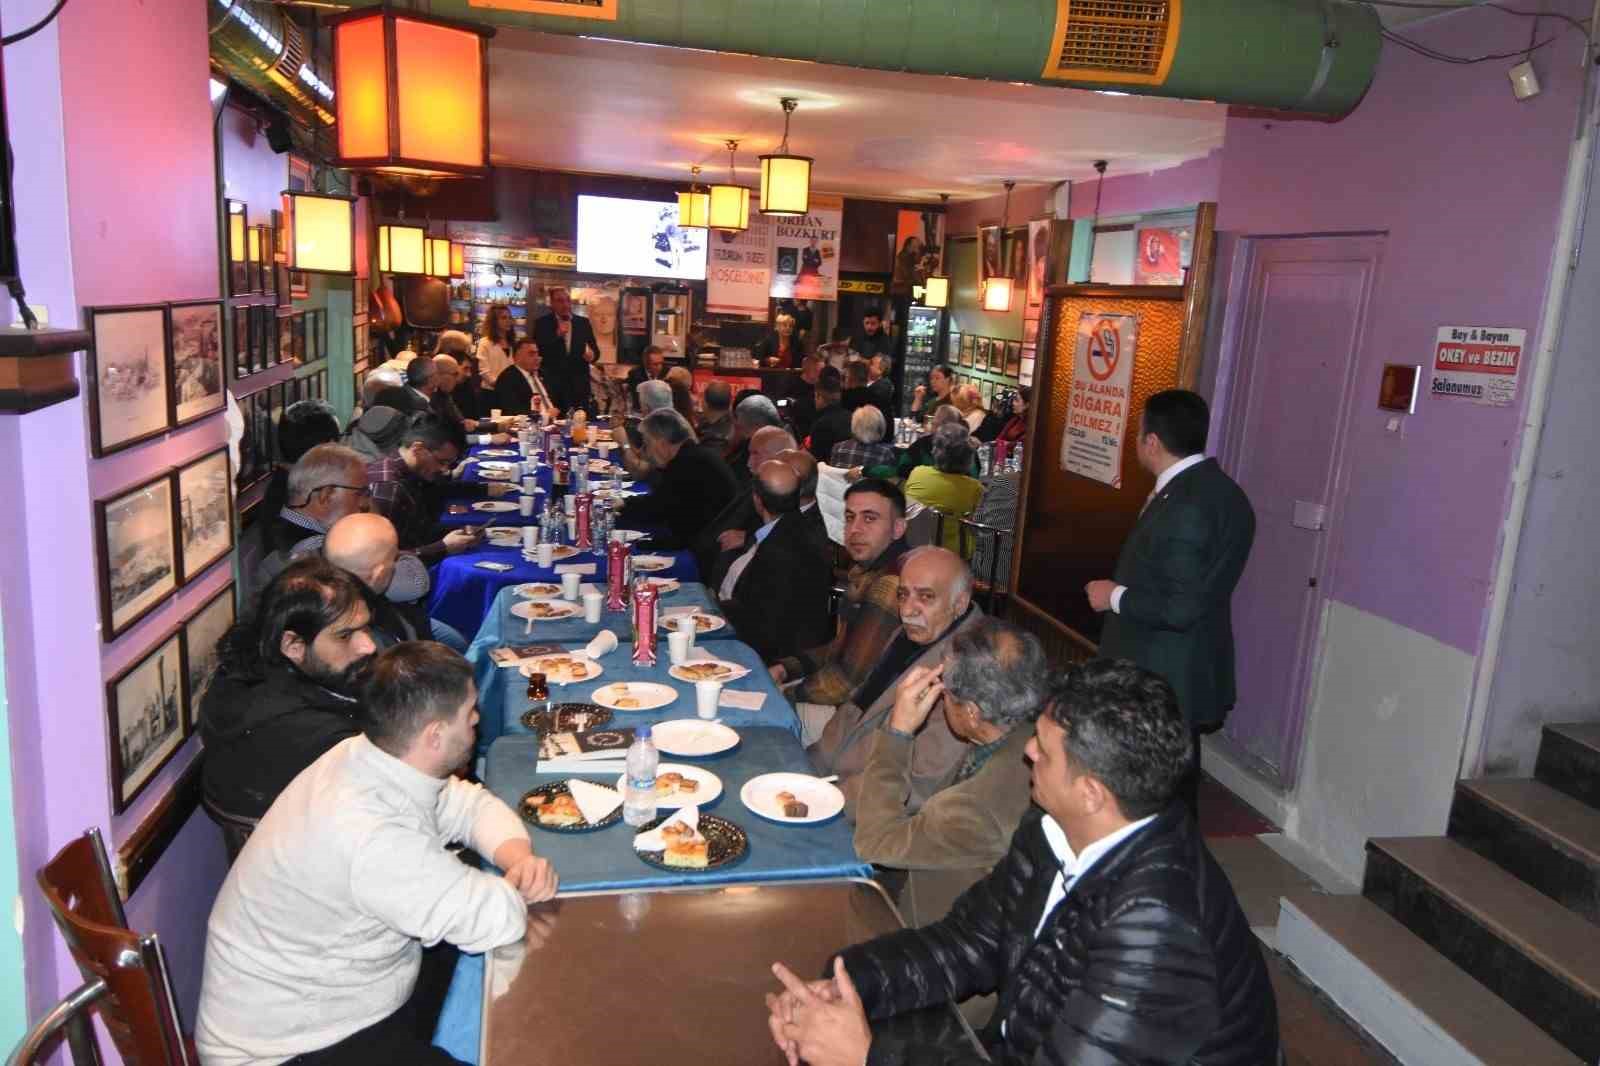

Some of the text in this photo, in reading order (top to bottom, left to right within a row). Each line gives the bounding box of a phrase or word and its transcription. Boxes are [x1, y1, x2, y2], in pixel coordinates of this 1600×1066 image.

[776, 226, 837, 241] BOZKURT
[1451, 328, 1510, 344] Bay & Bayan
[1468, 351, 1481, 364] ve
[1088, 383, 1126, 399] ALANDA
[1432, 377, 1483, 396] Salonumuz
[1072, 393, 1122, 418] SİGARA
